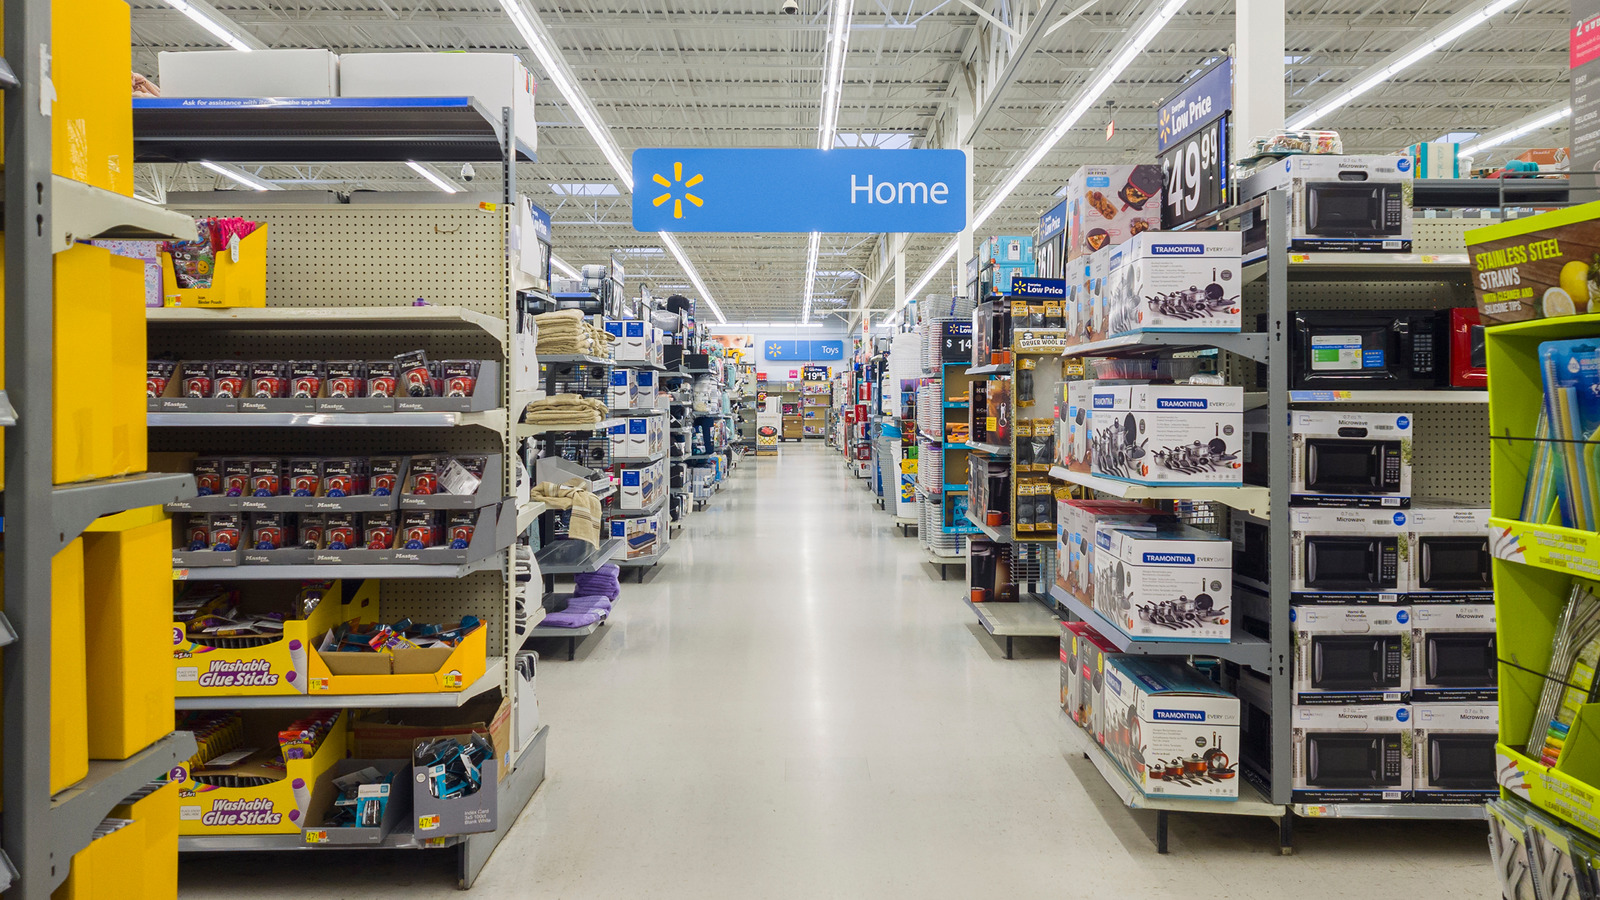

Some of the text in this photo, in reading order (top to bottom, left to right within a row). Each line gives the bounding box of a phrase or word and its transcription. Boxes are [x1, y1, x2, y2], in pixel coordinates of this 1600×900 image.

[1172, 96, 1212, 136] Low Price
[851, 174, 948, 204] Home
[1052, 216, 1060, 232] Price
[1475, 238, 1563, 271] STAINLESS STEEL
[1480, 267, 1520, 290] STRAWS
[1497, 289, 1520, 301] CLEANER
[1521, 287, 1534, 298] AND
[1484, 301, 1521, 315] SILICONE TIPS
[822, 346, 839, 355] Toys
[210, 660, 270, 672] Washable
[200, 672, 279, 686] Glue Sticks
[175, 769, 181, 777] 2
[213, 799, 273, 811] Washable
[202, 812, 237, 825] Glue
[237, 811, 282, 824] Sticks
